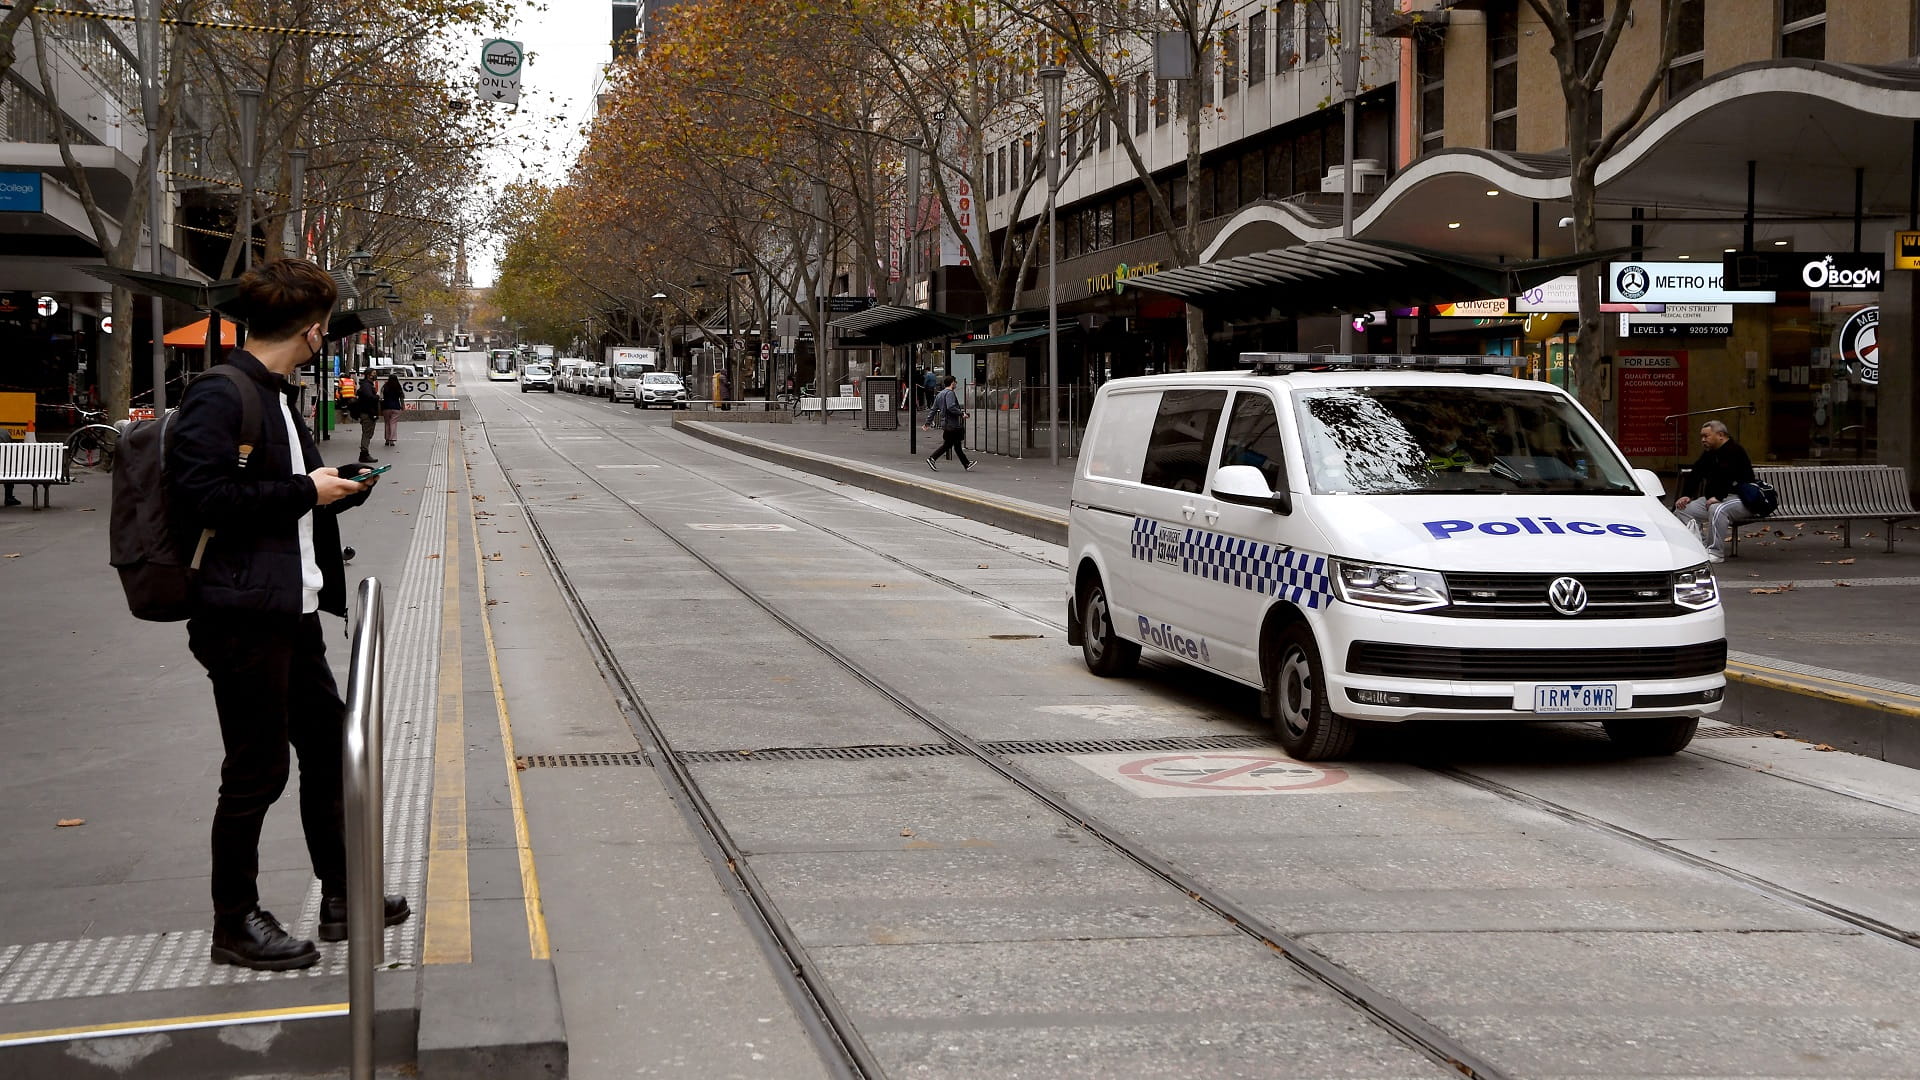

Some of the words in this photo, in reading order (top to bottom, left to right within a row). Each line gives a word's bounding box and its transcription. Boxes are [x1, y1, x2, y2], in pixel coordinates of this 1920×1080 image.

[482, 77, 518, 89] ONLY
[935, 111, 946, 120] 42
[1087, 273, 1114, 294] TIVOLI
[1655, 276, 1704, 289] METRO
[1455, 299, 1506, 312] Converge
[1624, 358, 1643, 366] FOR
[1644, 358, 1671, 366] LEASE
[1422, 516, 1647, 541] Police
[1138, 615, 1199, 660] Police
[1541, 689, 1570, 706] 1RM
[1583, 689, 1613, 706] 8WR
